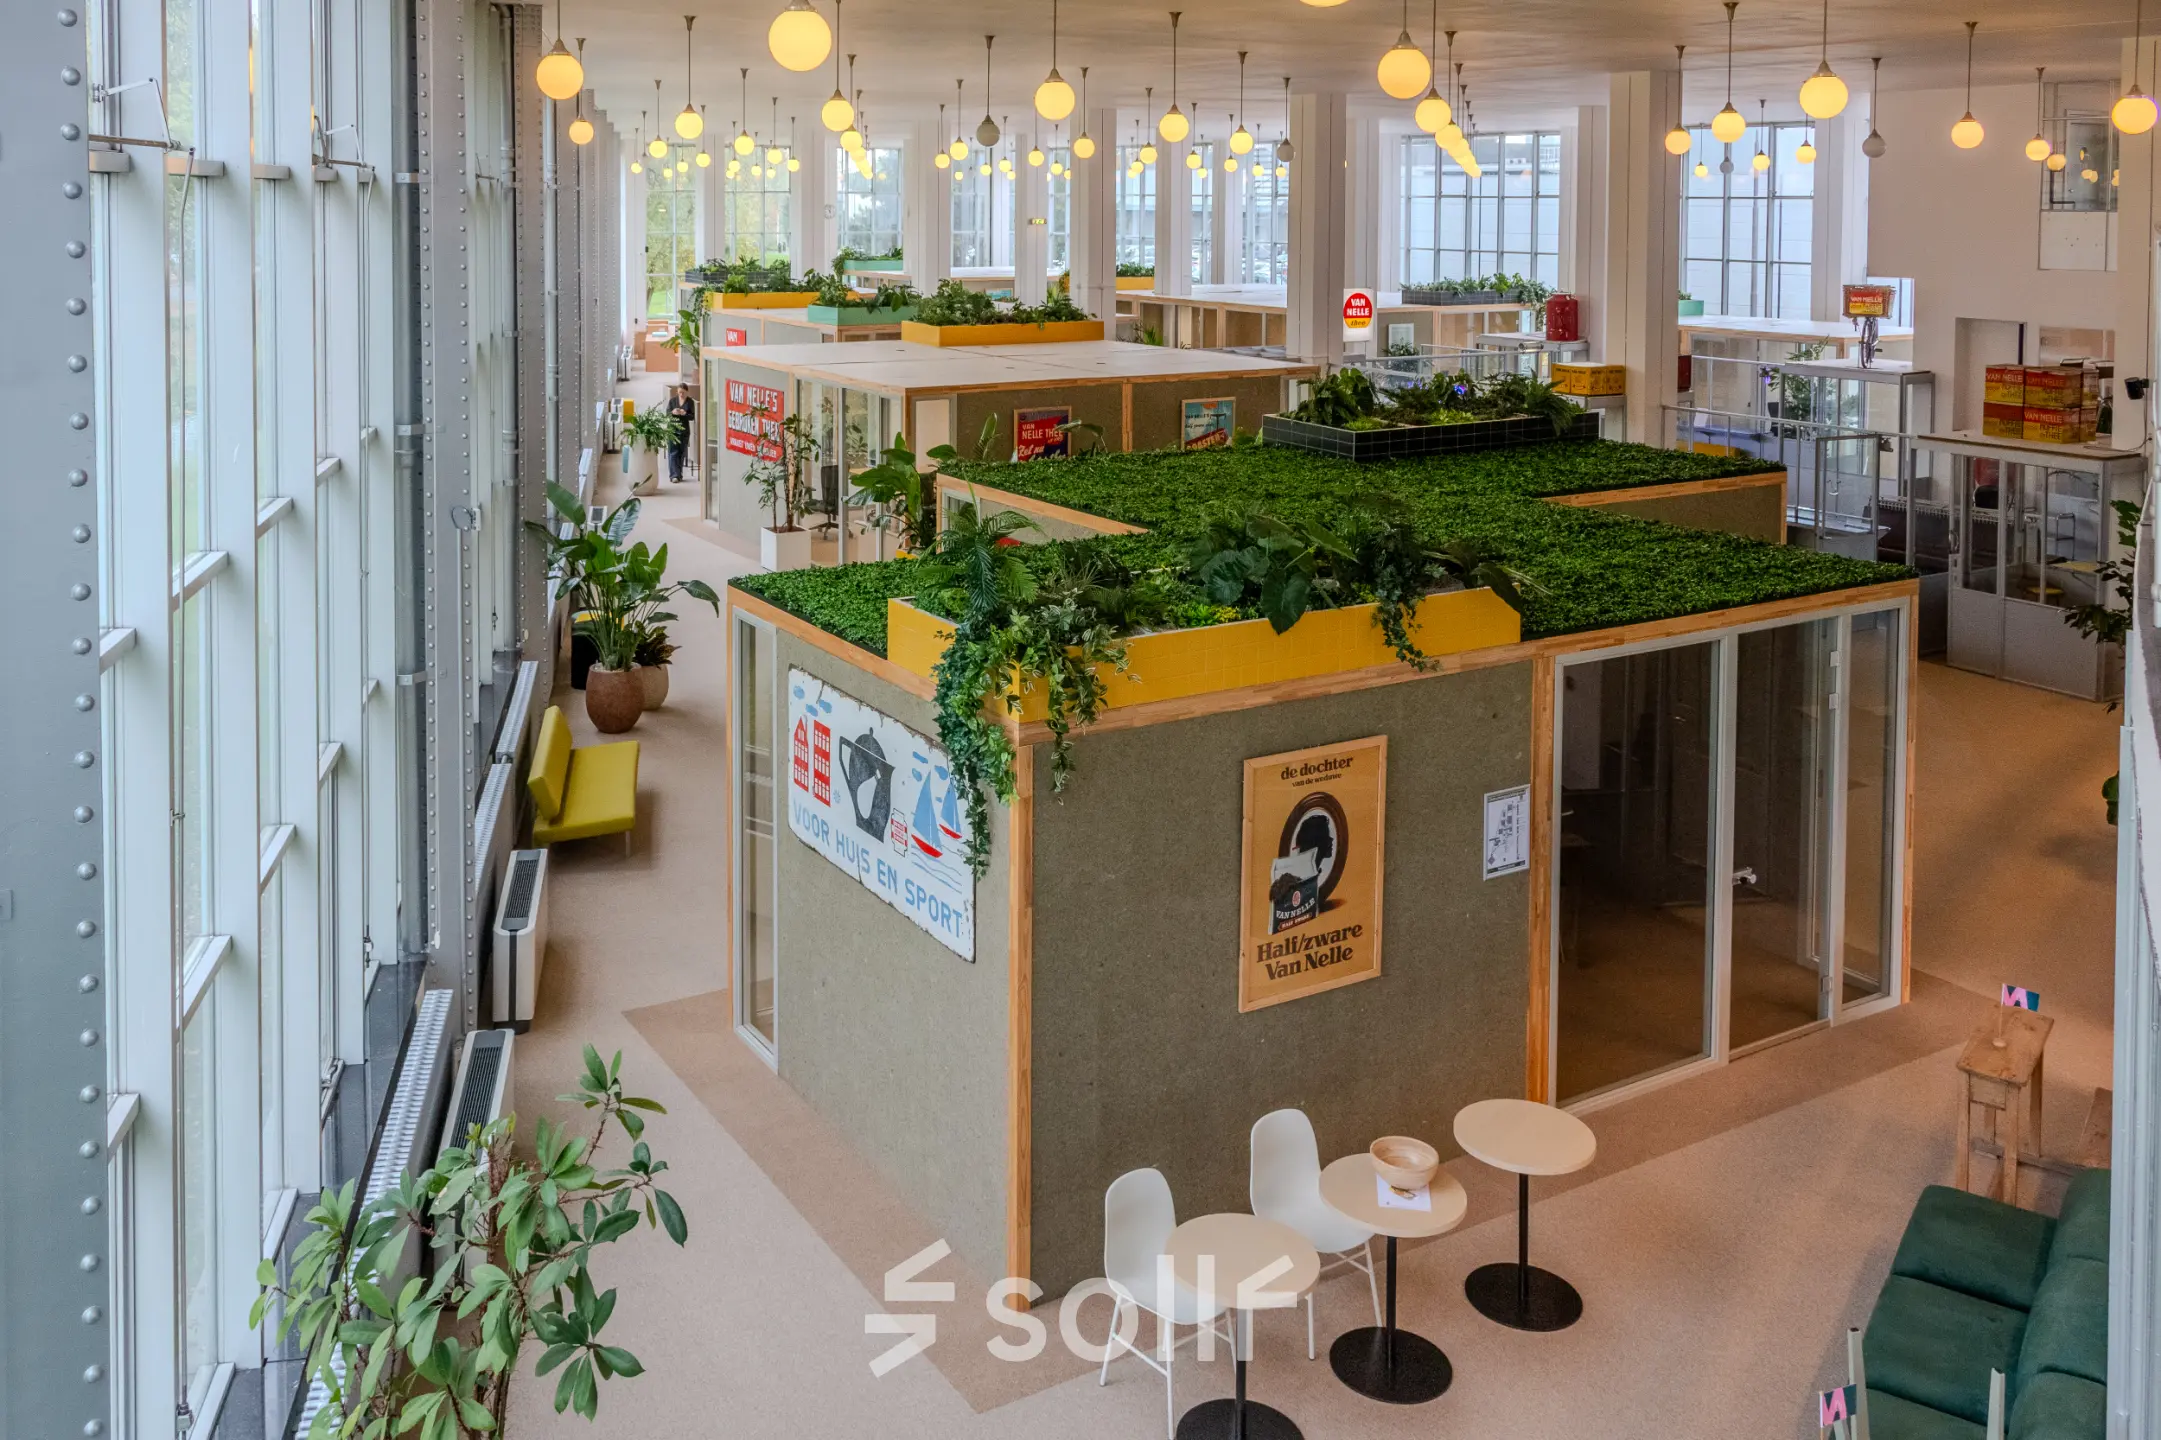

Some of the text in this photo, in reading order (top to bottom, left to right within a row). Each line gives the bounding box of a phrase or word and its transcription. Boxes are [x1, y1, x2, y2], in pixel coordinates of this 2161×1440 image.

[1351, 298, 1365, 307] VAN
[1346, 307, 1370, 316] NELLE
[1986, 372, 2024, 383] VAN NELLE
[729, 382, 779, 413] VAN NELLE'S
[2024, 411, 2064, 425] VAN NELLE
[1022, 423, 1035, 431] VAN
[1022, 428, 1044, 440] NELLE
[1281, 755, 1354, 781] de dochter
[1305, 776, 1315, 786] de
[792, 798, 830, 847] VOOR
[836, 828, 872, 875] HUIS
[877, 857, 899, 896] EN
[905, 877, 963, 939] SPORT
[1276, 898, 1317, 921] VAN NELLE
[1256, 922, 1363, 963] Half/zware
[1265, 944, 1354, 981] Van Nelle
